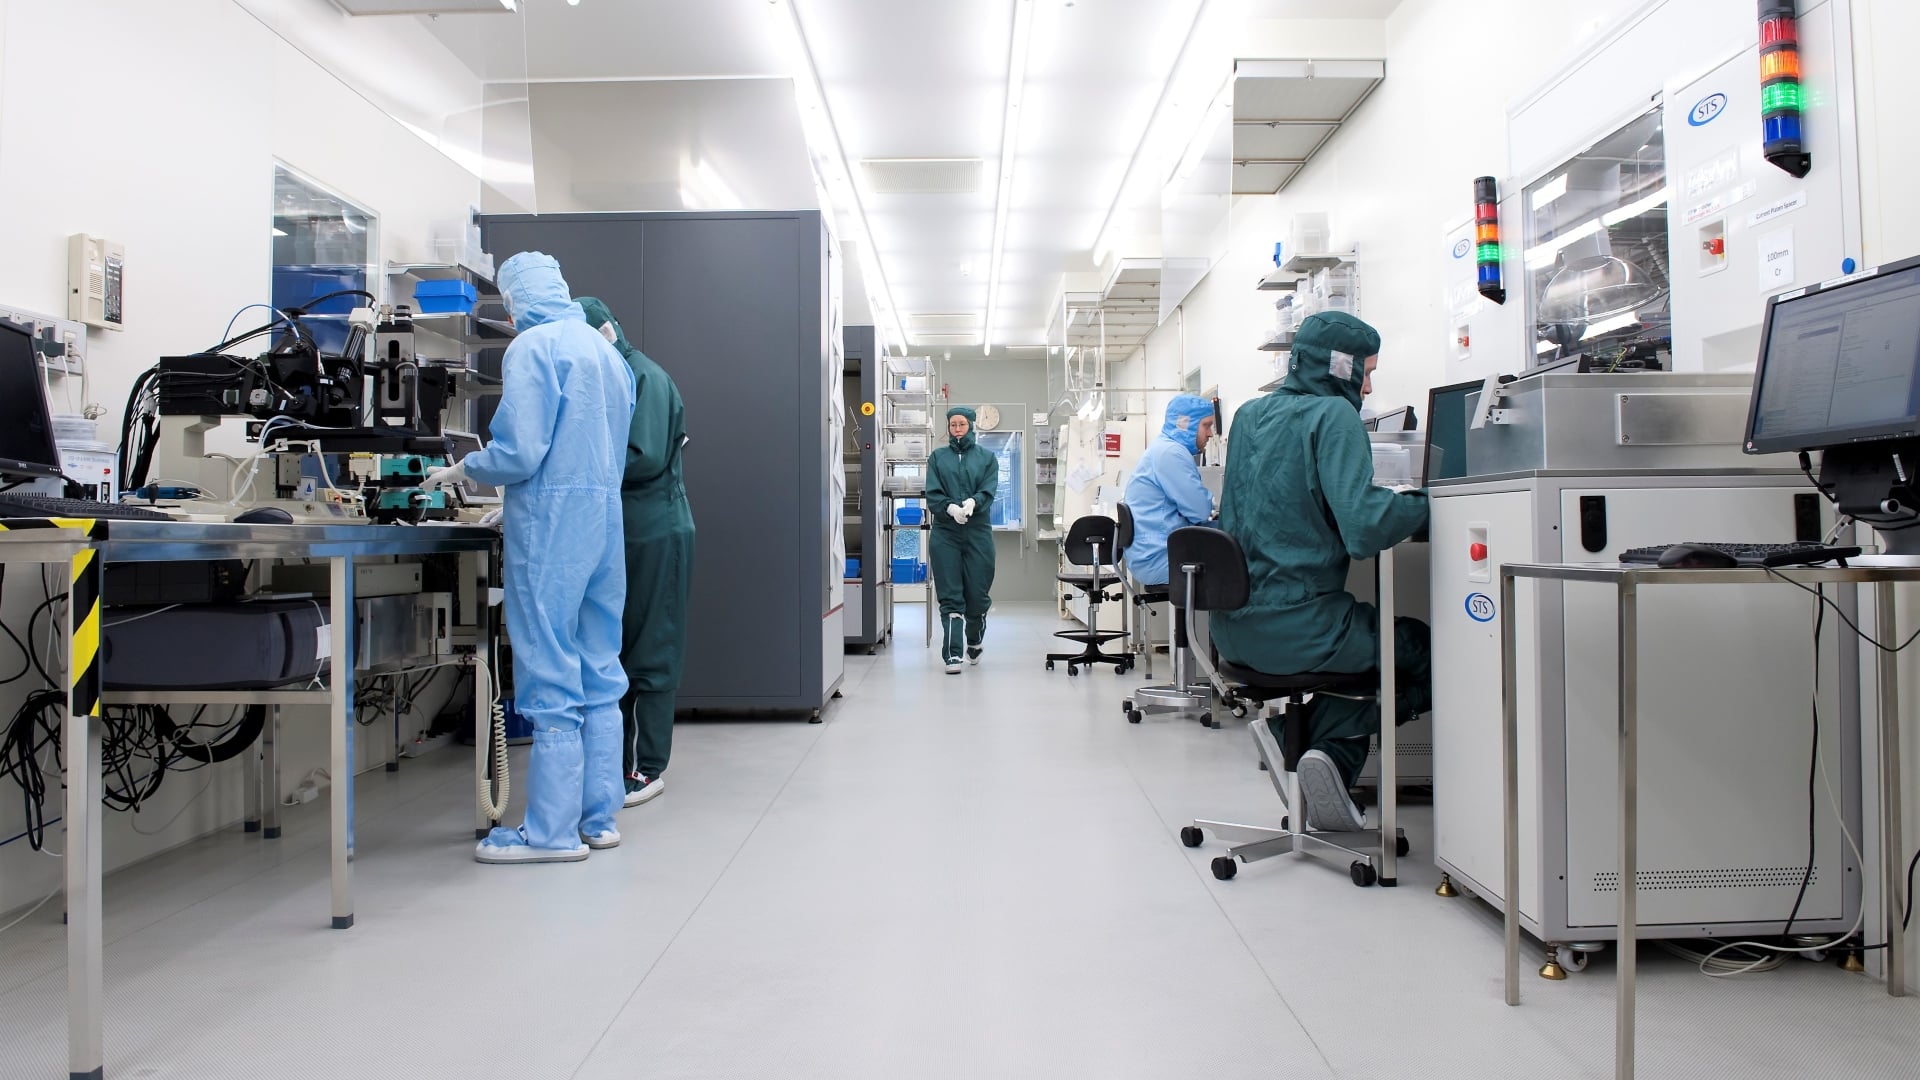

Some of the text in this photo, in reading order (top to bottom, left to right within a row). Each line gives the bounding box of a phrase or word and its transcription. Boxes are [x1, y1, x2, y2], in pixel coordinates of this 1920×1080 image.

[1698, 98, 1717, 119] STS
[1767, 249, 1789, 262] 100mm
[1473, 600, 1488, 614] STS
